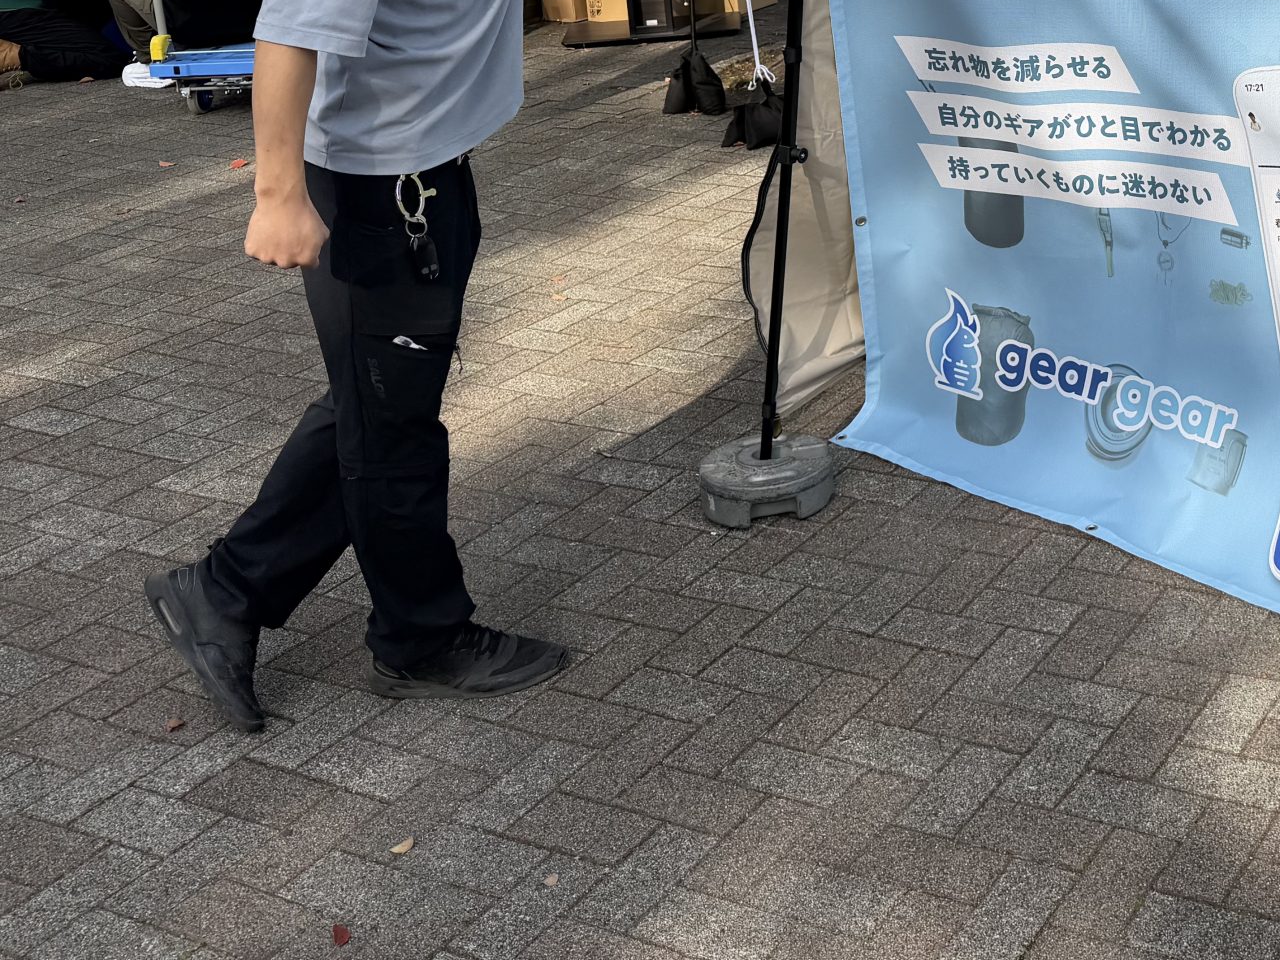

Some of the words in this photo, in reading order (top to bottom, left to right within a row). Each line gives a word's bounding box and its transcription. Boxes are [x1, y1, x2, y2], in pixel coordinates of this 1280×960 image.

[924, 48, 1112, 82] 忘れ物を減らせる
[1244, 83, 1264, 92] 17:21
[937, 103, 1232, 152] 自分のギアがひと目でわかる
[947, 156, 1212, 206] 持っていくものに迷わない
[995, 339, 1112, 406] gear
[1113, 375, 1238, 448] gear
